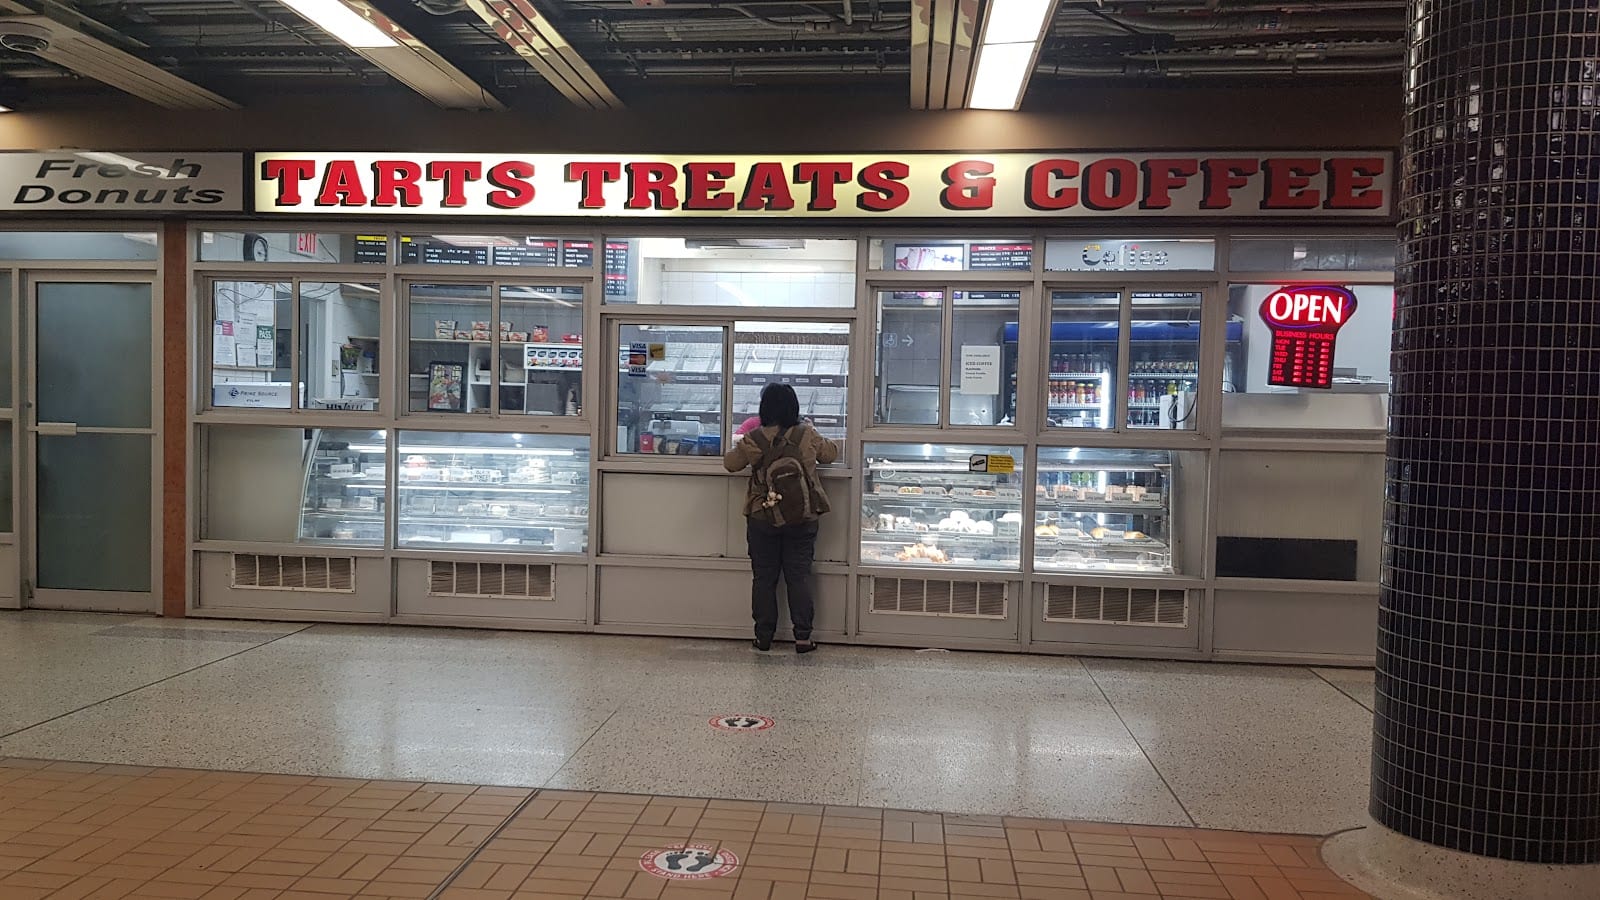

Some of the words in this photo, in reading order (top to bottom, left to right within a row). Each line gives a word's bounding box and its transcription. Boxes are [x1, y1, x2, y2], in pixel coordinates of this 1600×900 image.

[35, 158, 202, 178] Fresh
[13, 184, 225, 204] Donuts
[261, 159, 536, 209] TARTS
[564, 160, 910, 212] TREATS
[939, 160, 996, 210] &
[1024, 158, 1384, 210] COFFEE
[298, 233, 317, 254] EXIT
[1269, 293, 1343, 323] OPEN
[259, 330, 272, 339] PASS
[1275, 331, 1307, 339] BUSINESS
[651, 868, 681, 879] STAND
